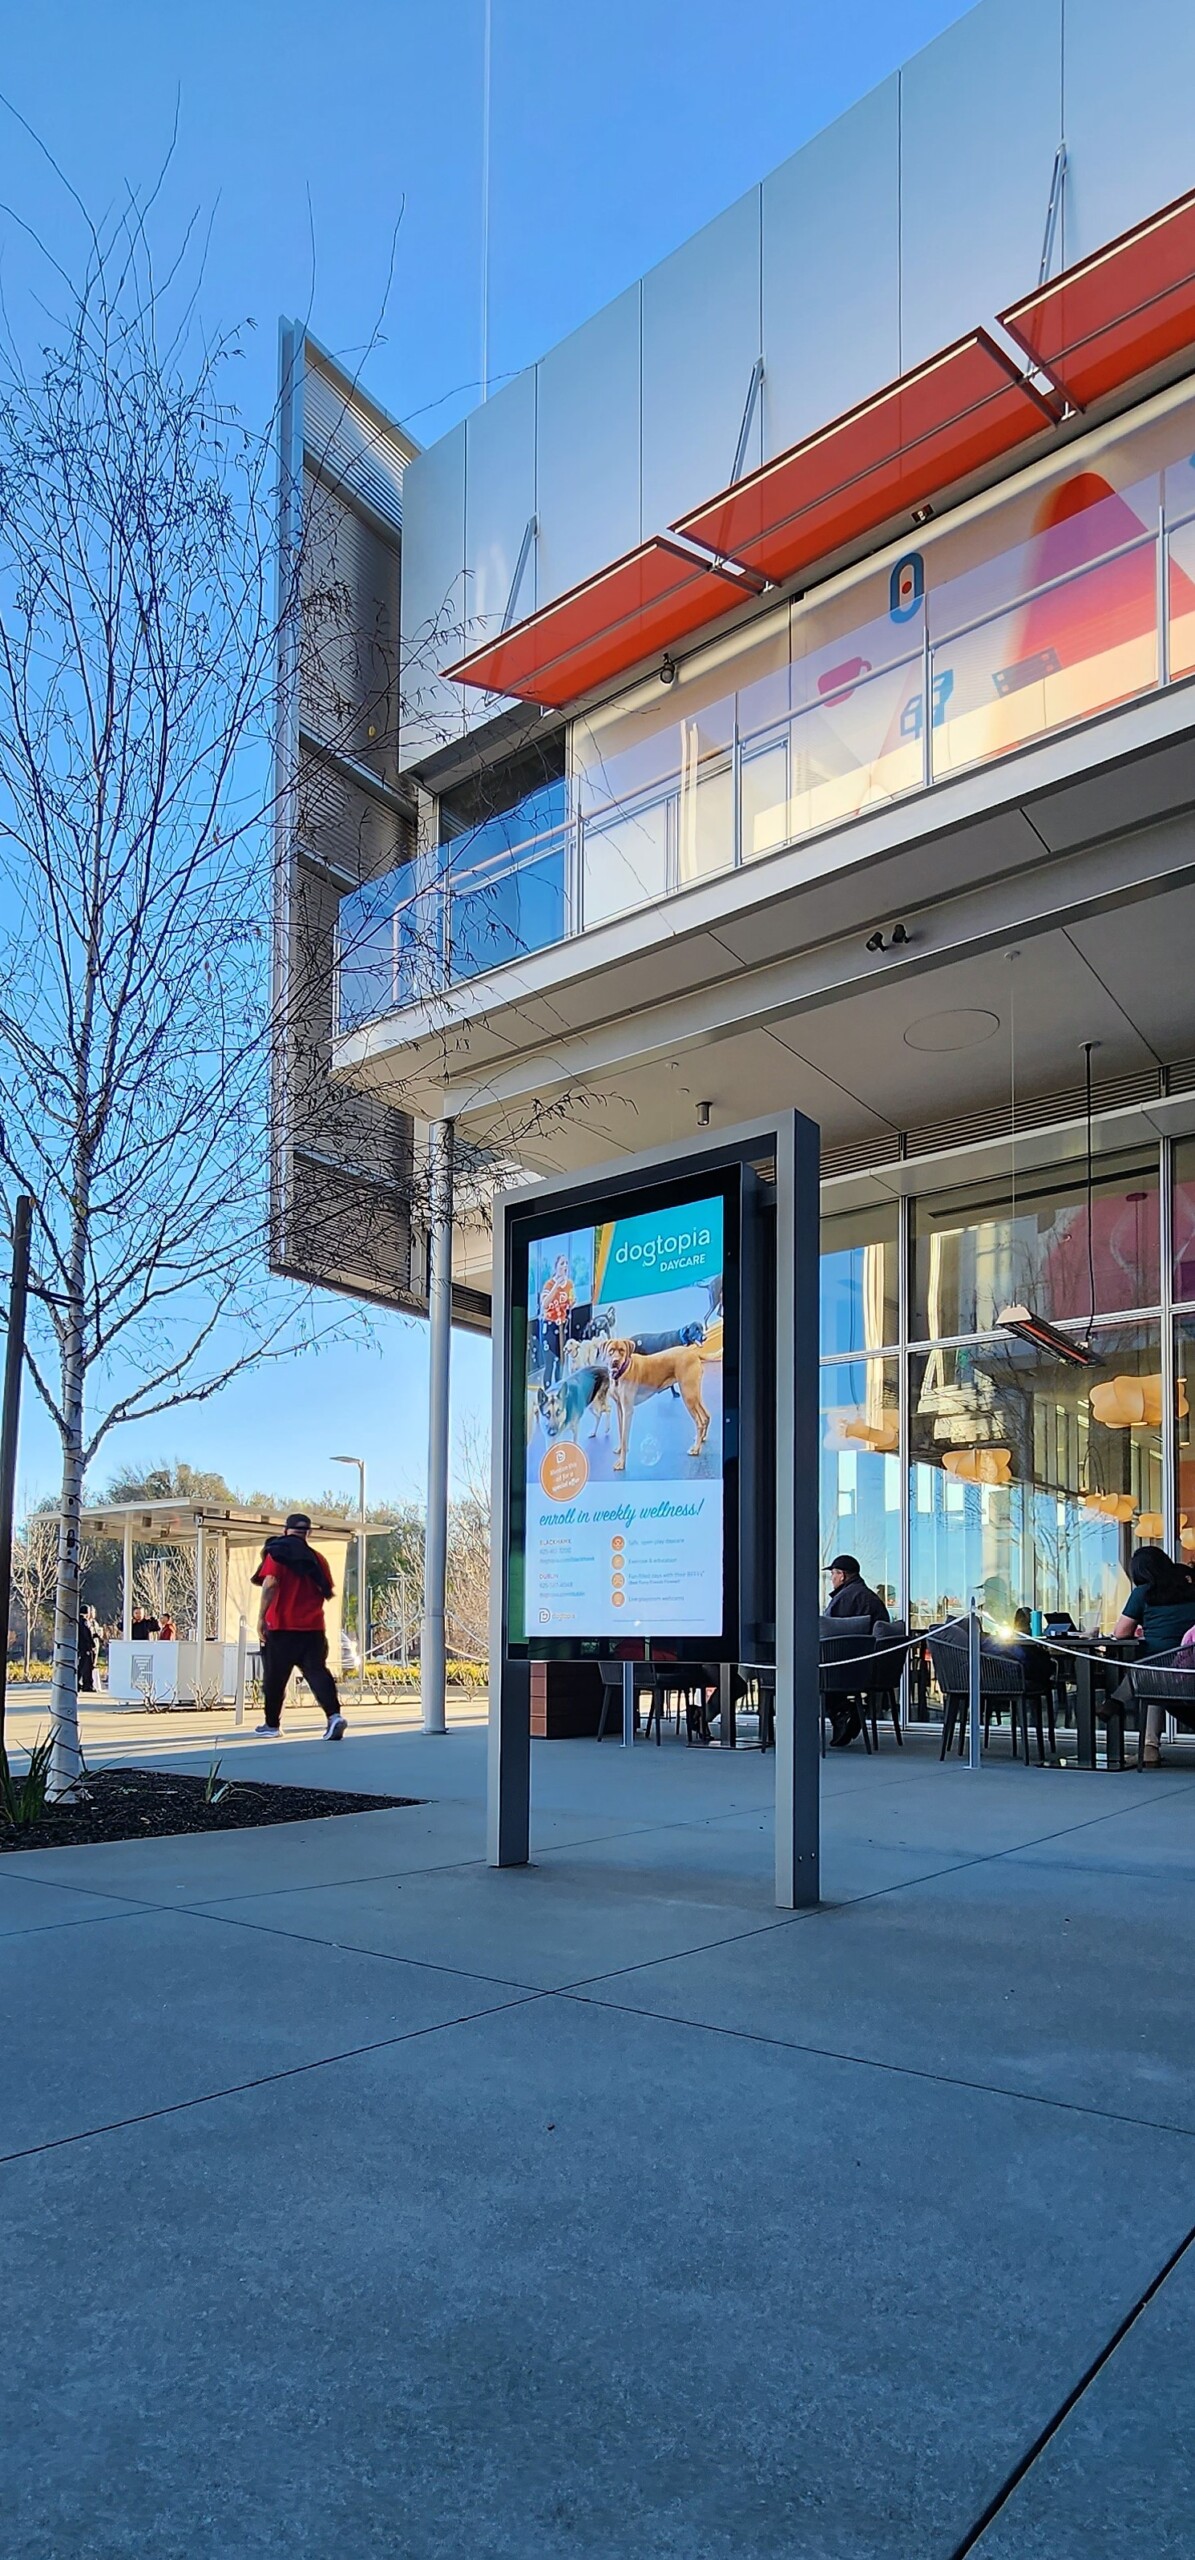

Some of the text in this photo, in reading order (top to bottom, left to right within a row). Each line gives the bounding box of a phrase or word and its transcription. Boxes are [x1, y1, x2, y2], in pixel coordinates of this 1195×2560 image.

[615, 1226, 711, 1267] dogtopia
[660, 1253, 706, 1273] DAYCARE
[539, 1498, 705, 1528] enroll in weekly wellness!
